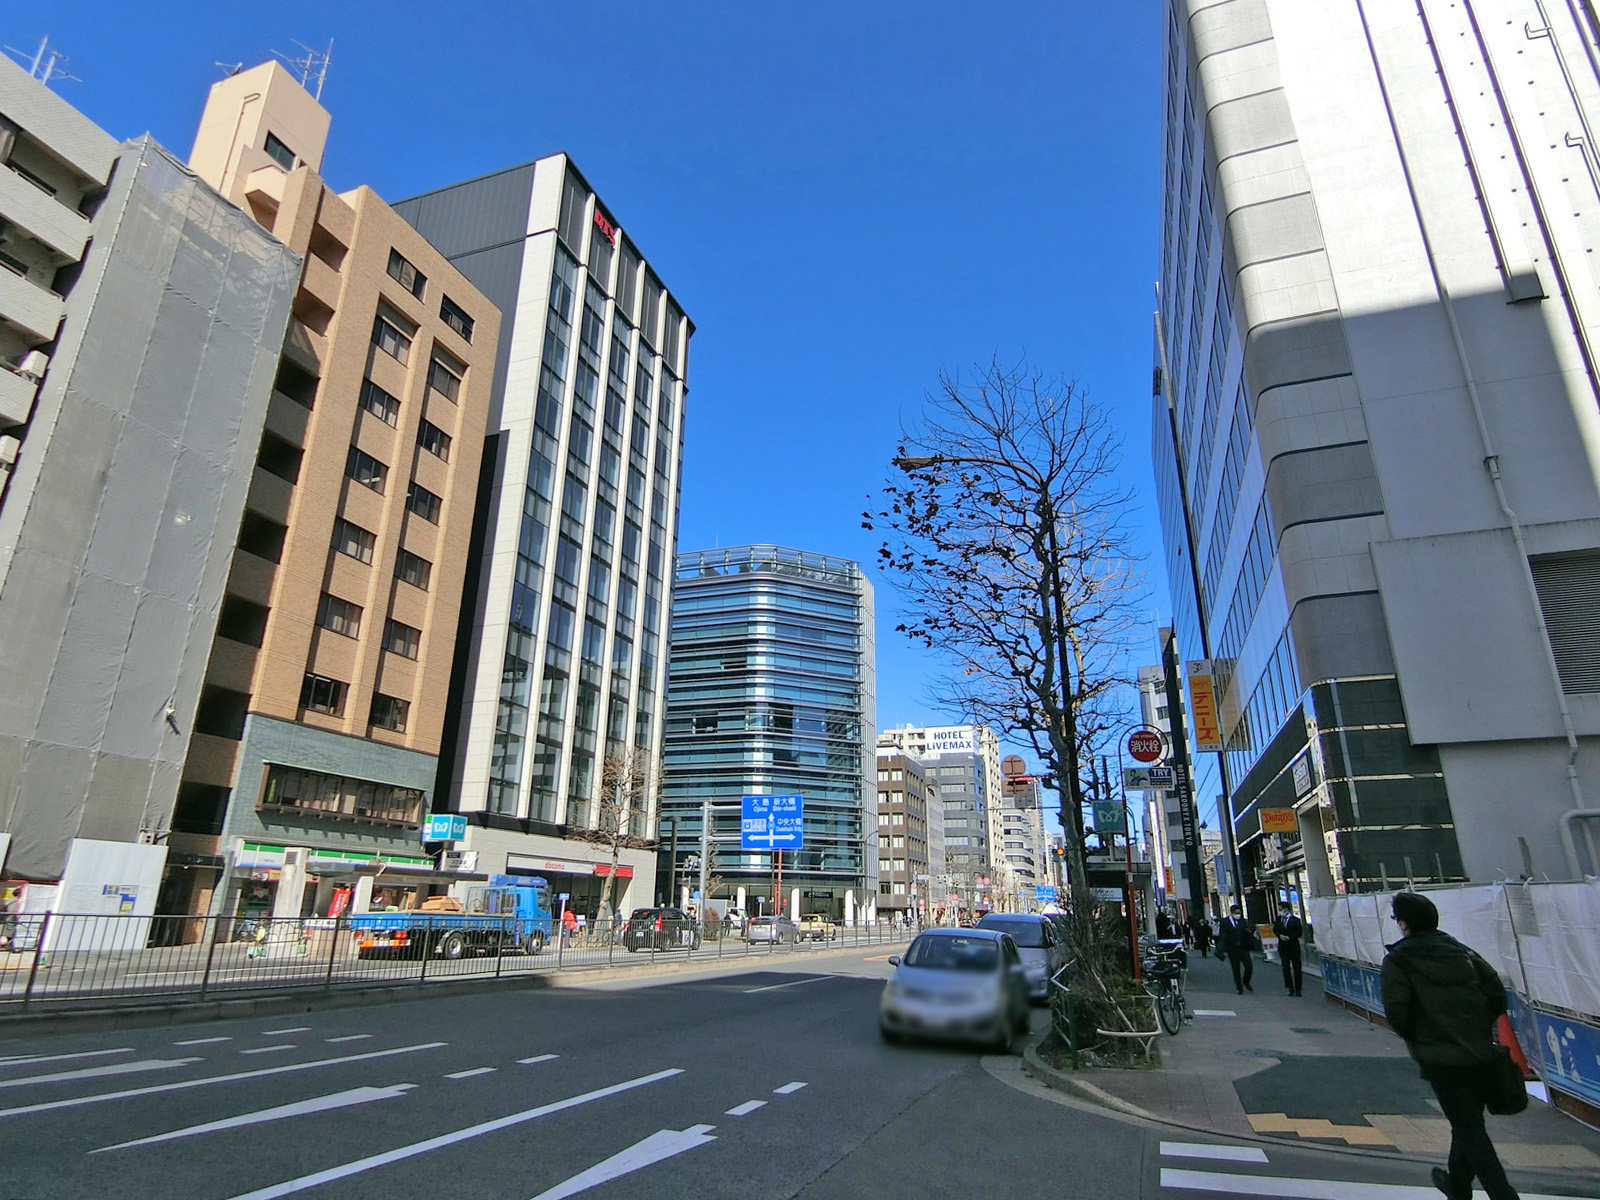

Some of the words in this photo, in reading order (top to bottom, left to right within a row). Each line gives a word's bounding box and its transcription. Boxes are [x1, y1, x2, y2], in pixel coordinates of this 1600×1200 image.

[1194, 691, 1217, 741] デニーズ
[934, 731, 964, 740] HOTEL
[1130, 740, 1160, 752] 消火栓
[1152, 768, 1169, 777] TRY
[1177, 763, 1186, 784] HOTEL
[1179, 785, 1190, 822] SARDONYX
[777, 818, 801, 826] 中央大橋
[1183, 823, 1193, 846] TOKYO
[544, 861, 565, 870] docomo
